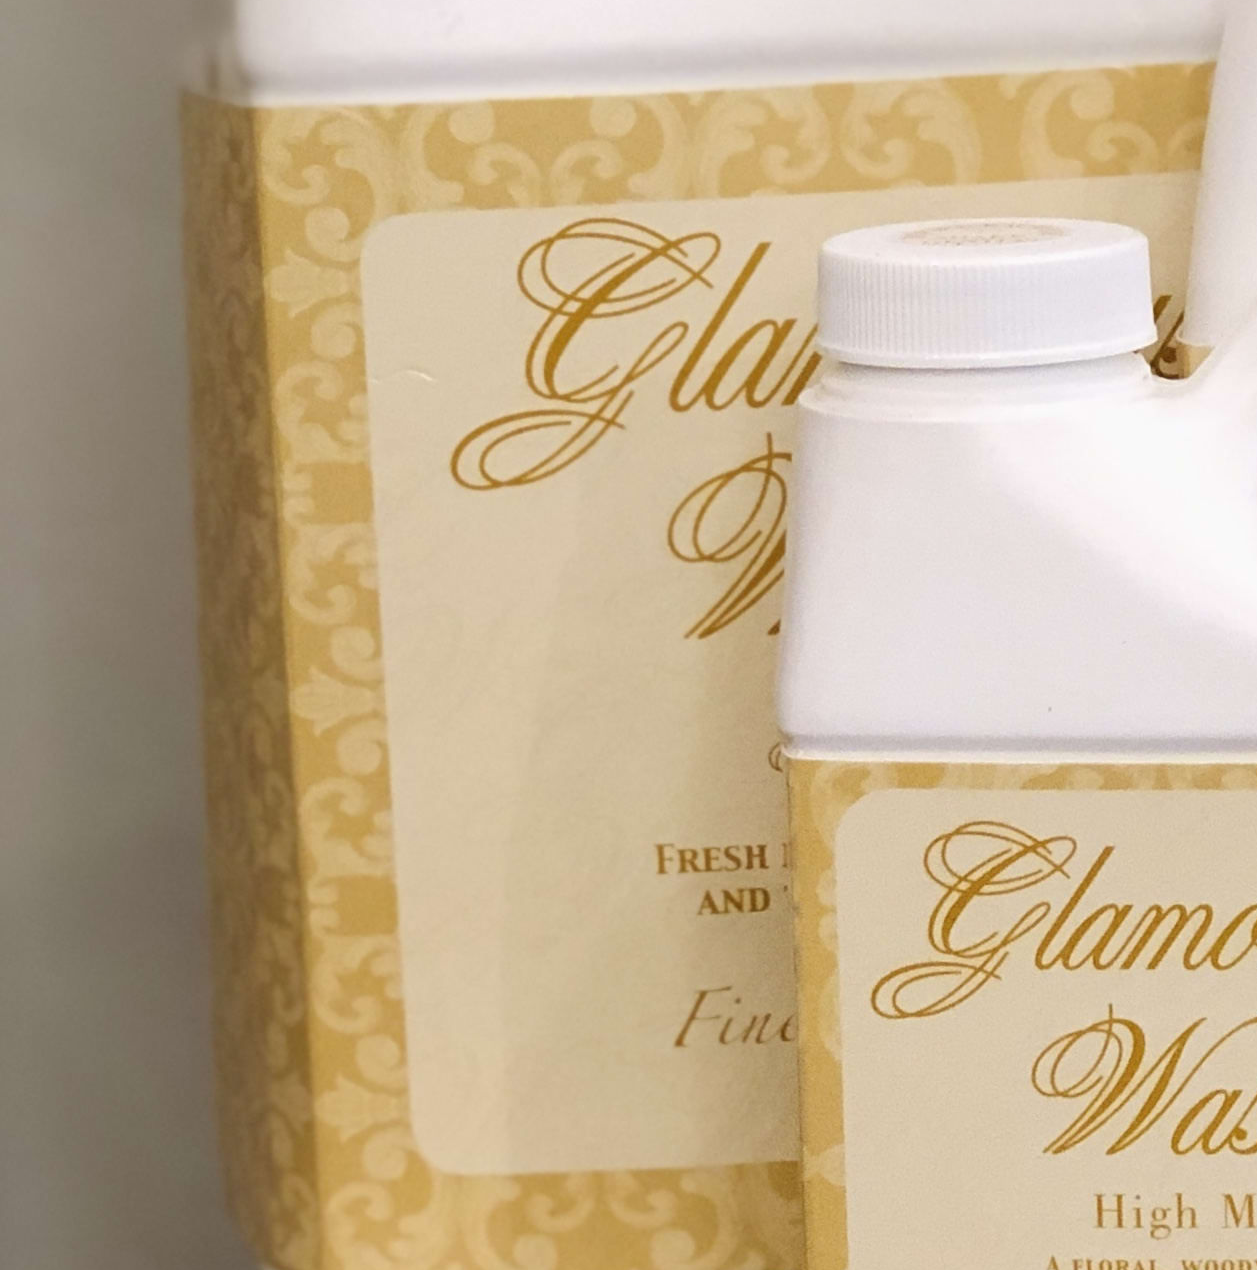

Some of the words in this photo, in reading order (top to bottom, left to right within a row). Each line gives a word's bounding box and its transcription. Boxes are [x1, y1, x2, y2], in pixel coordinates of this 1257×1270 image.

[657, 844, 770, 874] FRESH
[697, 886, 771, 916] AND
[1095, 1192, 1197, 1239] High
